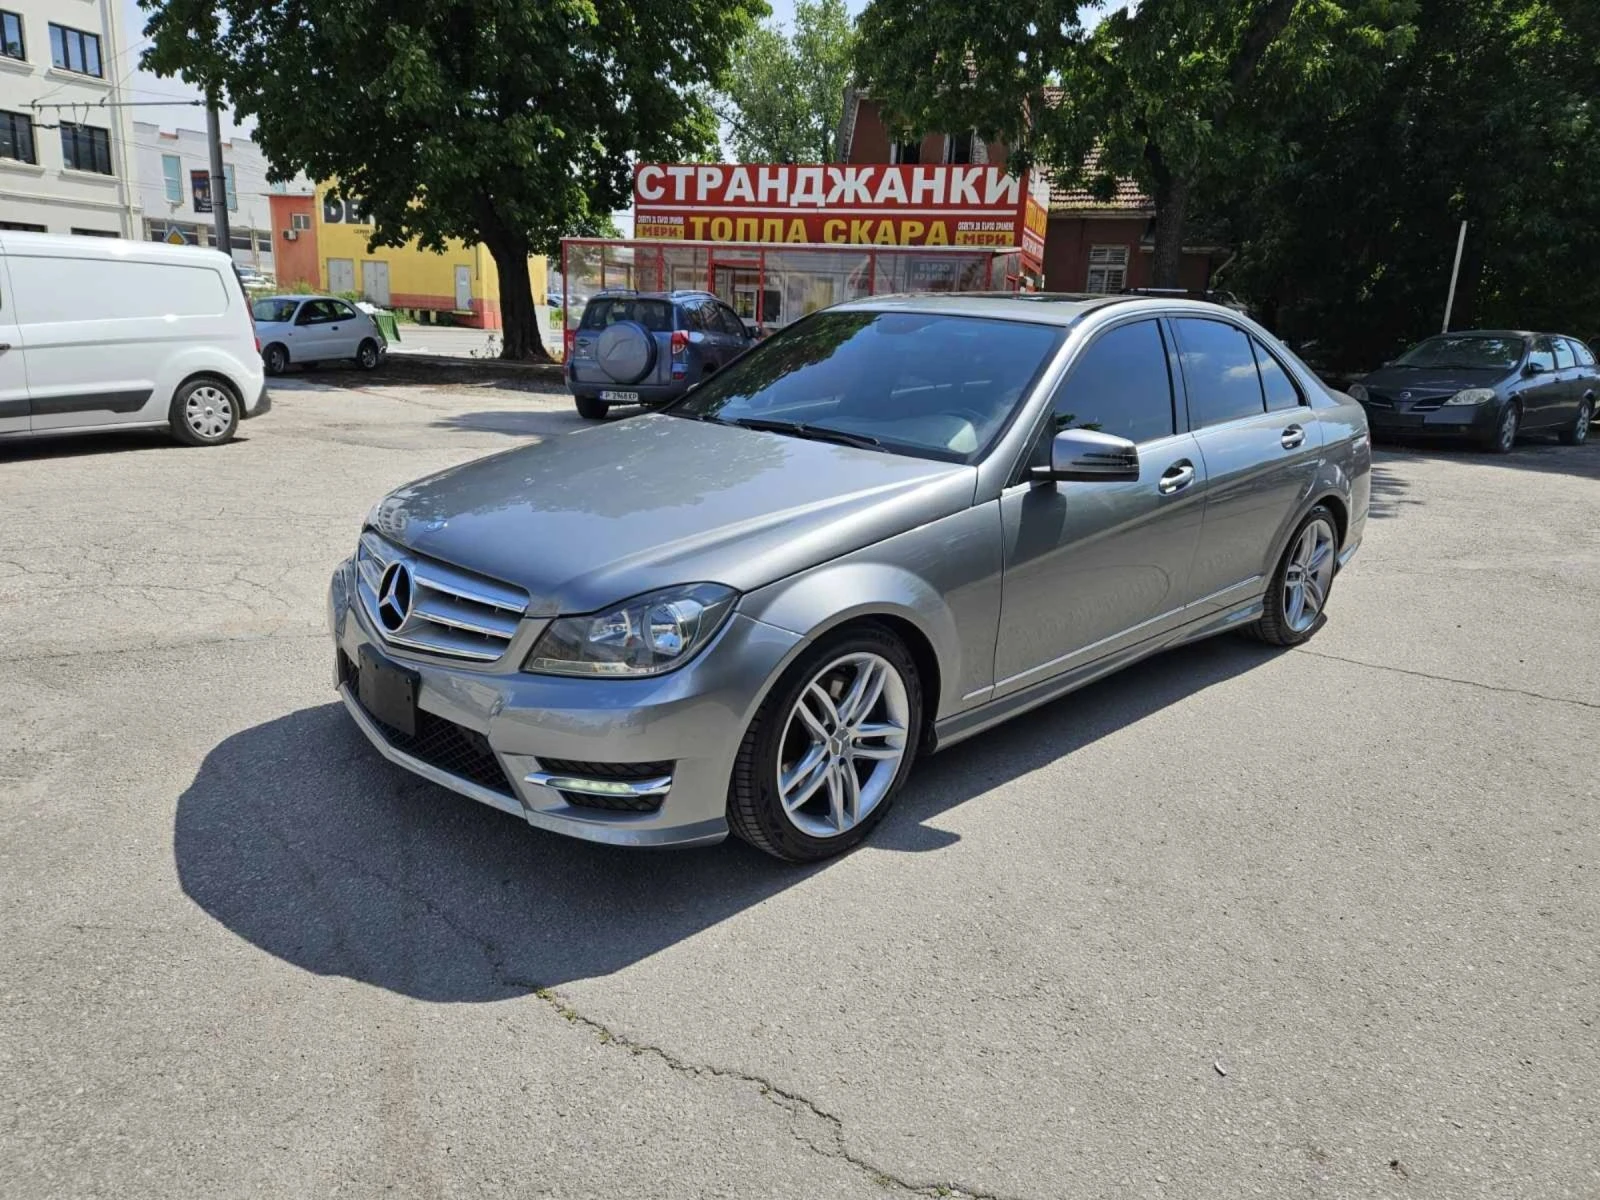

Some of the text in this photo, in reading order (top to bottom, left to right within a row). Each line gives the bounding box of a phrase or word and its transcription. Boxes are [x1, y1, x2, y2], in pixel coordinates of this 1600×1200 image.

[637, 166, 1020, 207] СТРАНДЖАНКИ
[642, 226, 678, 236] МЕРИ
[690, 216, 949, 246] ТОПЛА СКАРА
[963, 233, 1006, 245] МЕРИ
